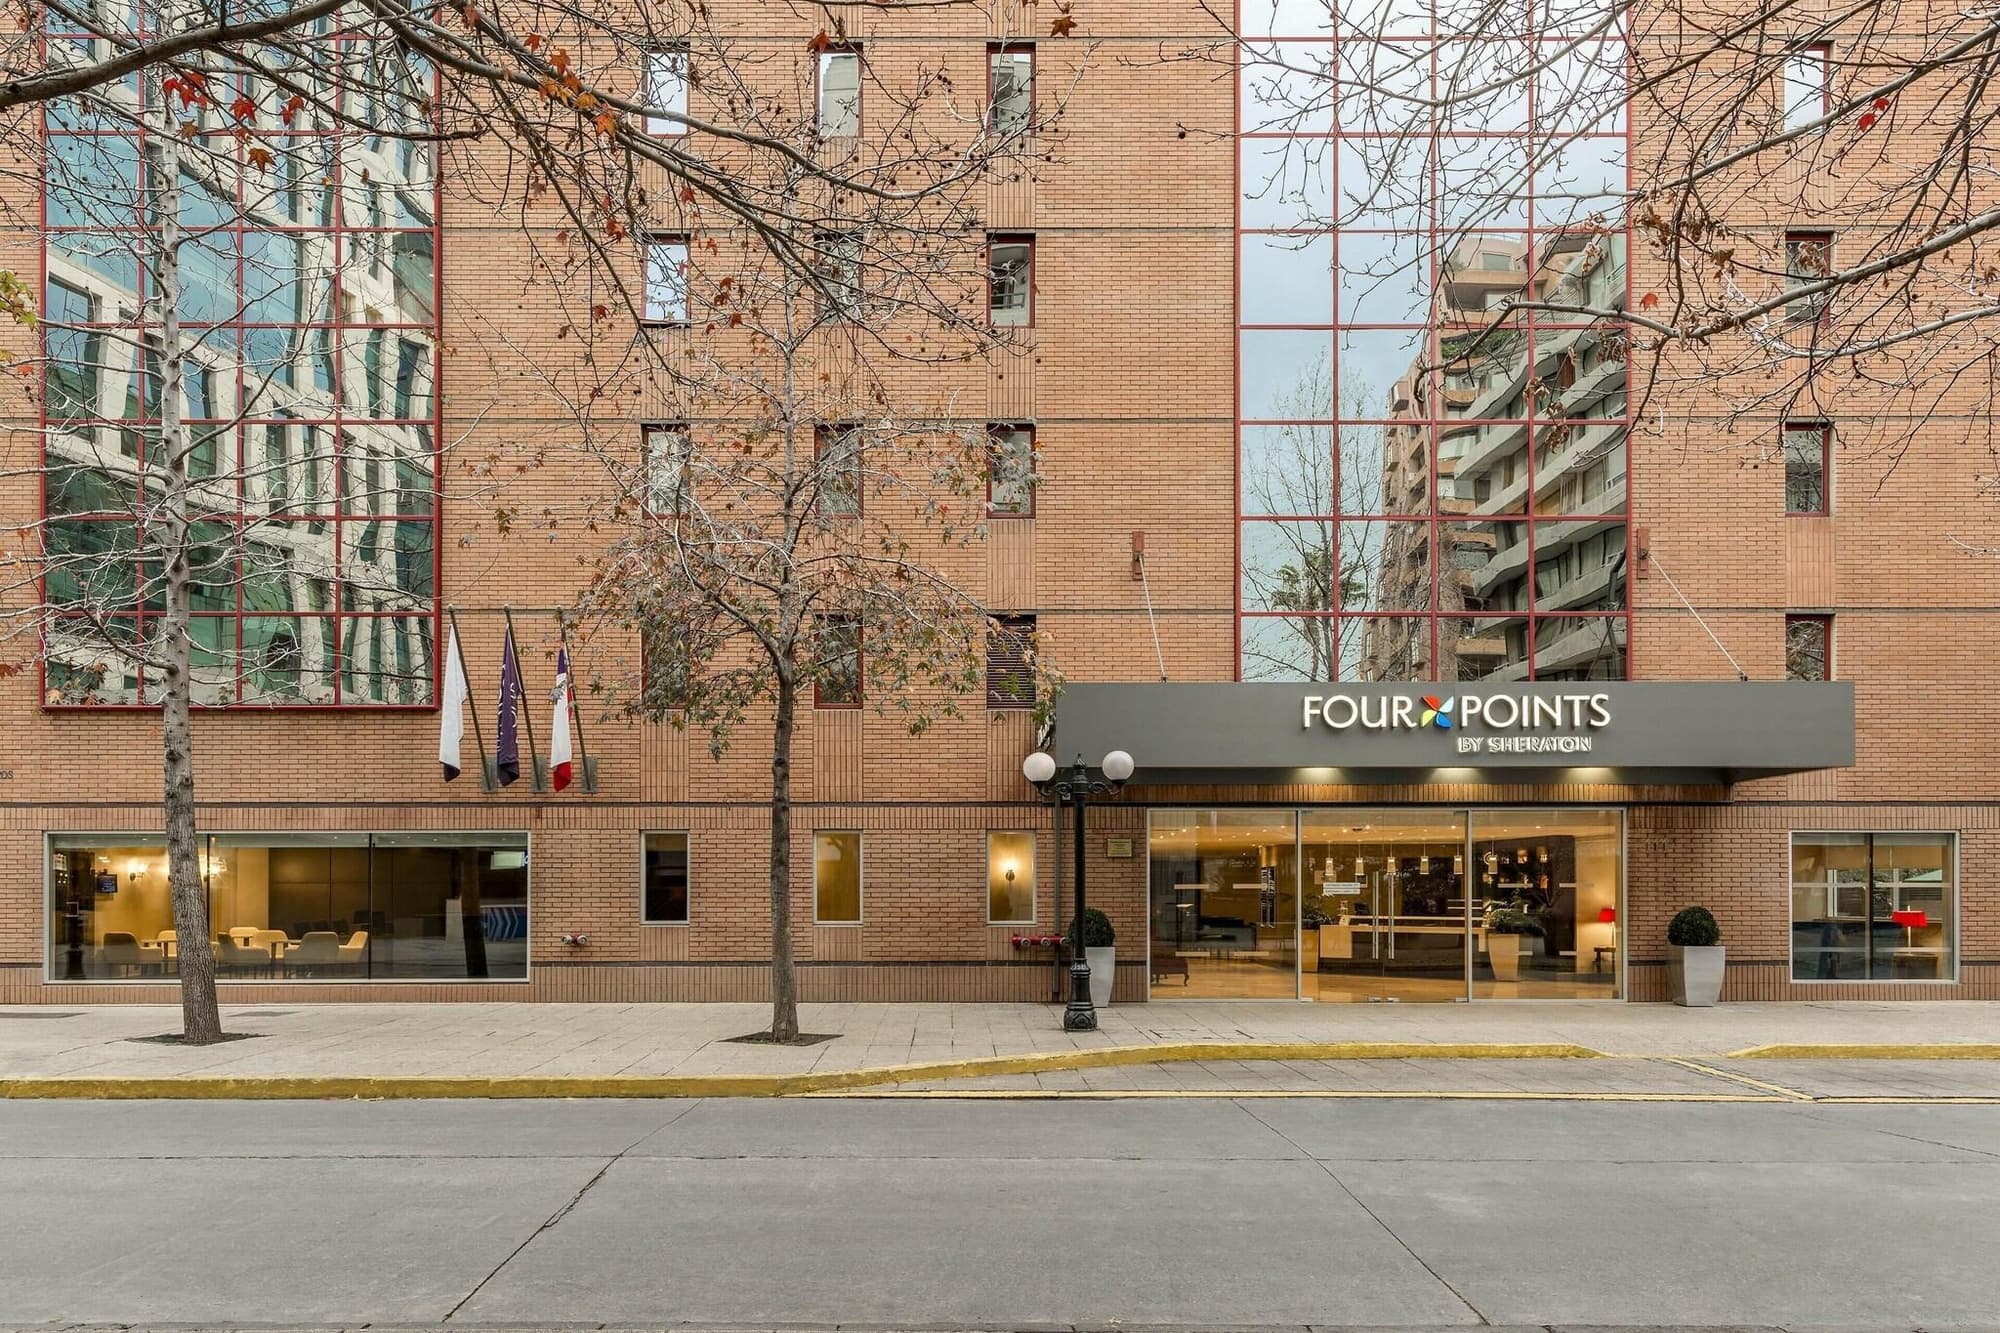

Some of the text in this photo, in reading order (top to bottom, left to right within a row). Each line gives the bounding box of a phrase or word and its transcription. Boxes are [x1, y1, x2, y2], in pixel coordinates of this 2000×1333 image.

[1304, 693, 1611, 728] FOUR POINTS
[1457, 736, 1592, 752] BY SHERATON
